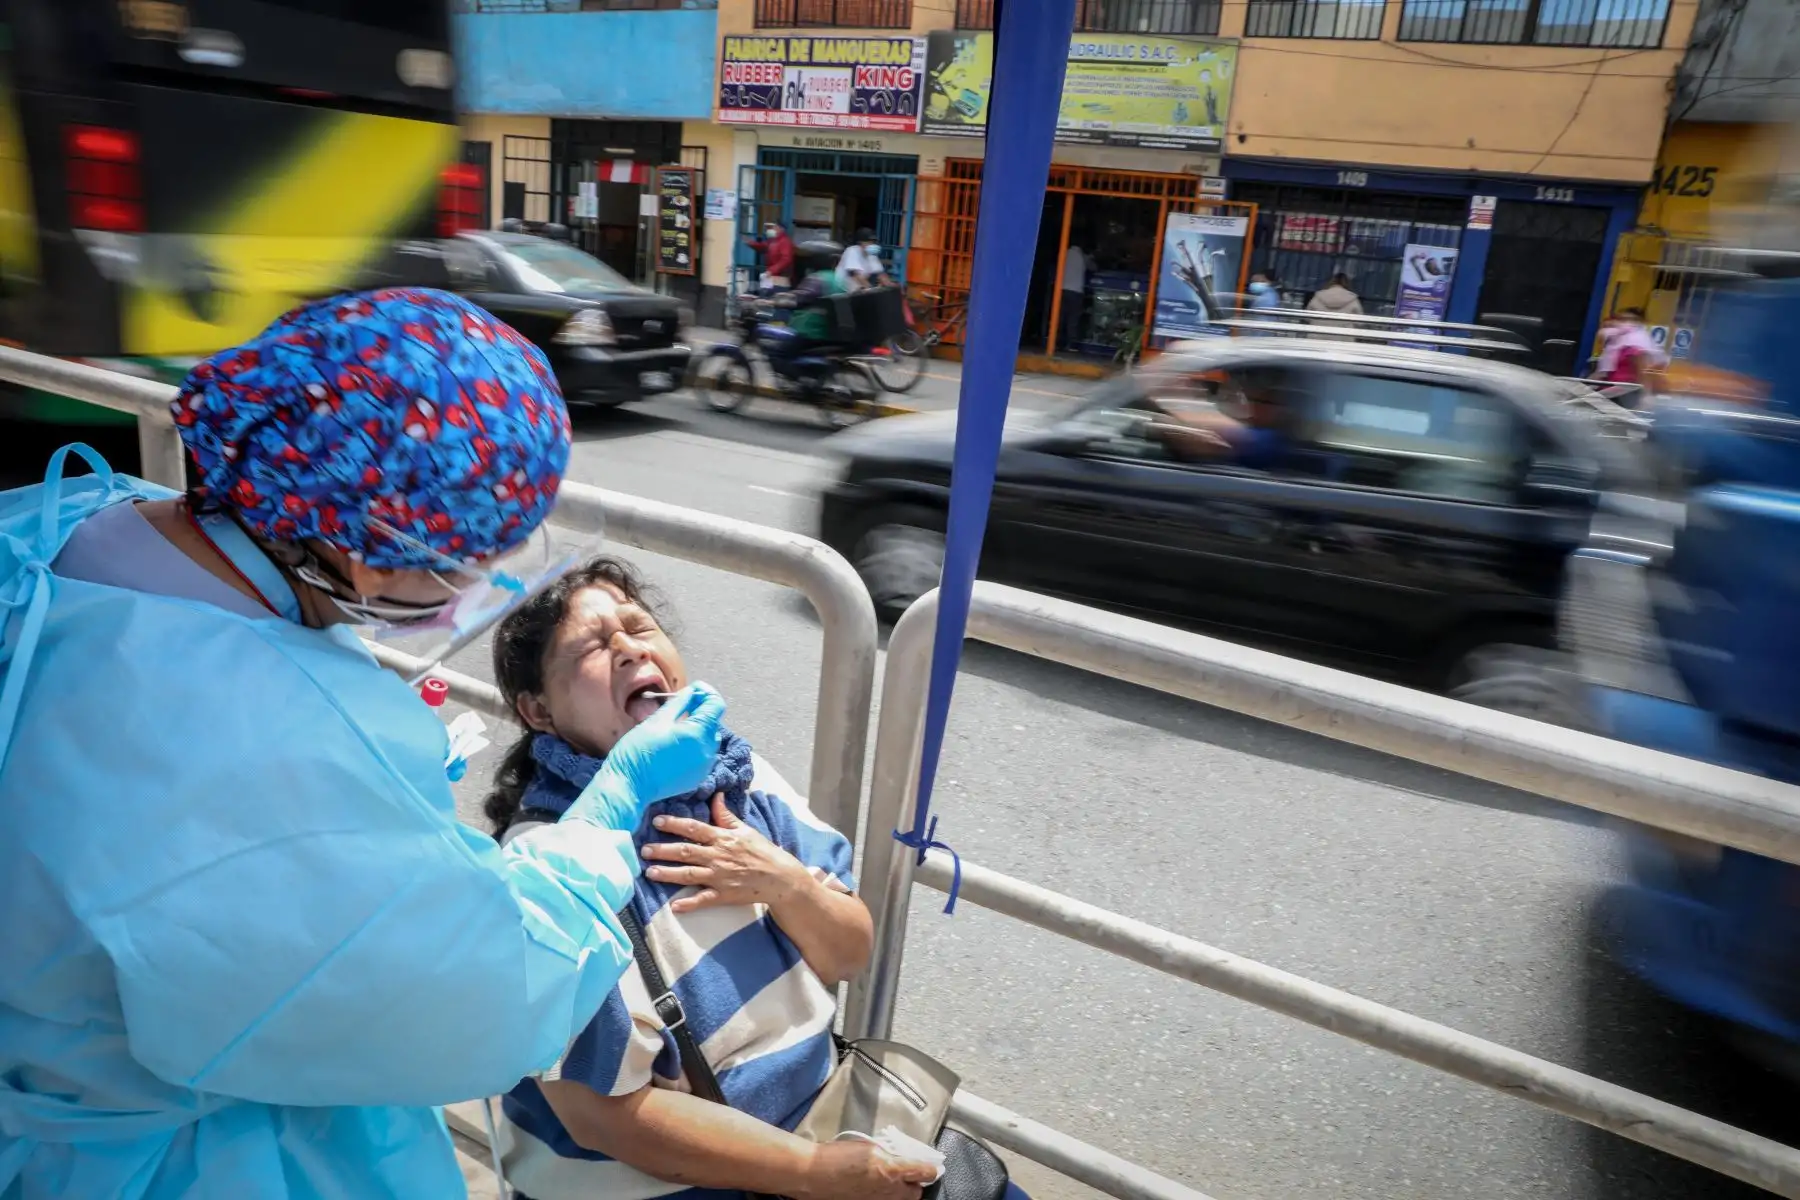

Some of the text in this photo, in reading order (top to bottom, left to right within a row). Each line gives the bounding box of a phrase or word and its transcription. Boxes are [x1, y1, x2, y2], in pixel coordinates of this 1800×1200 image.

[725, 38, 787, 62] FABRICA
[789, 39, 811, 62] DE
[812, 40, 912, 64] MANGUERAS
[723, 62, 783, 85] RUBBER
[808, 76, 849, 93] RUBBER
[856, 65, 914, 89] KING
[806, 94, 834, 110] KING
[1653, 165, 1719, 198] 1425
[1535, 186, 1574, 202] 1411
